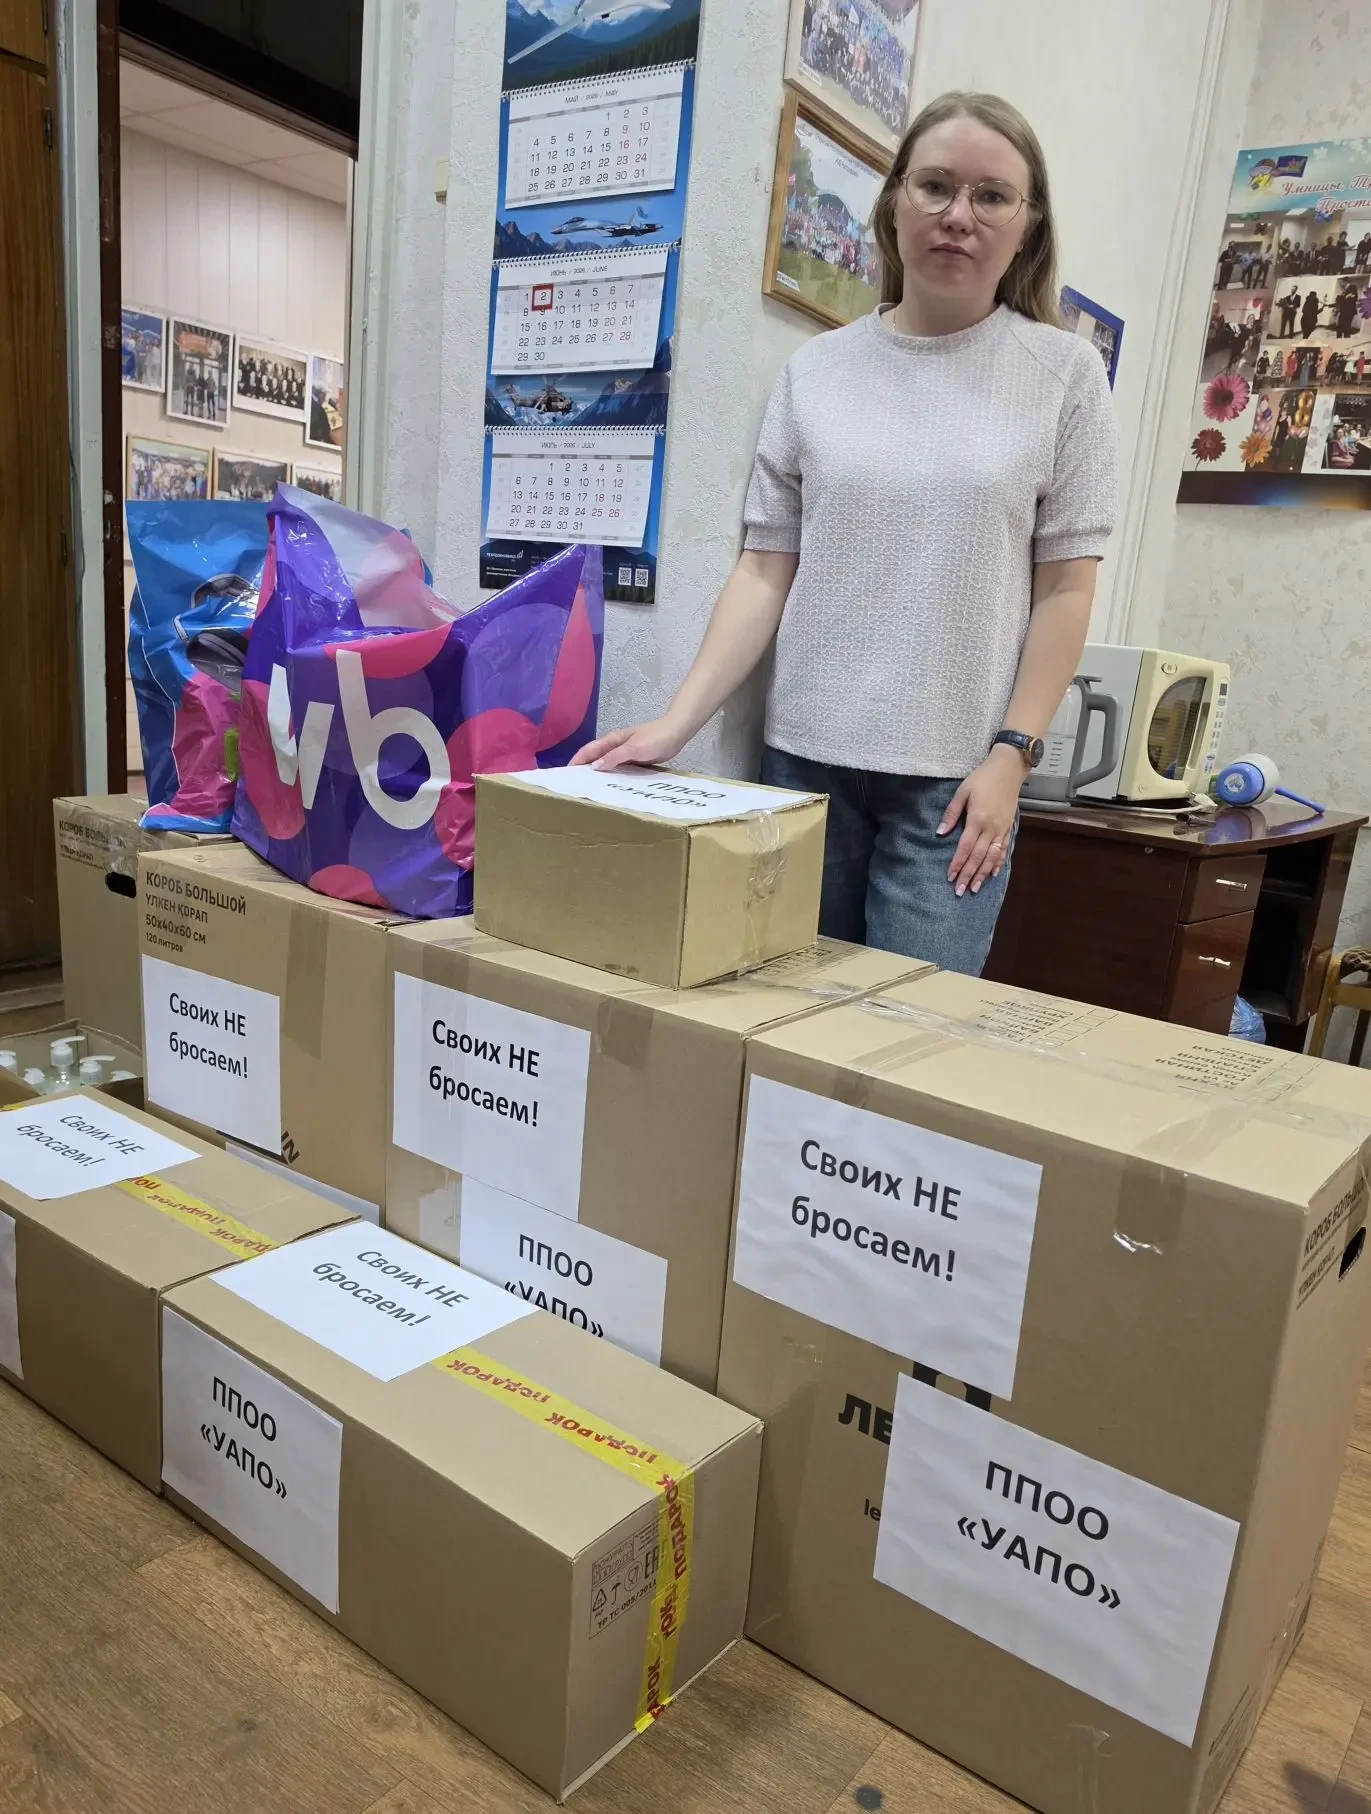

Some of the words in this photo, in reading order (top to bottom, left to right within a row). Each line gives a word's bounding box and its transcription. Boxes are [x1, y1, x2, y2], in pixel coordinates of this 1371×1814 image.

[624, 109, 630, 118] 2
[642, 106, 648, 116] 3
[550, 136, 556, 144] 5
[568, 133, 574, 142] 6
[586, 130, 592, 140] 7
[604, 128, 610, 136] 8
[622, 124, 628, 134] 9
[640, 121, 650, 131] 10
[531, 153, 540, 162] 11
[548, 150, 558, 159] 12
[565, 148, 576, 156] 13
[583, 145, 592, 154] 14
[601, 142, 611, 152] 15
[619, 140, 630, 149] 16
[638, 137, 648, 147] 17
[530, 168, 540, 176] 18
[547, 165, 556, 174] 19
[562, 162, 574, 172] 20
[580, 160, 590, 170] 21
[598, 158, 610, 168] 22
[616, 155, 628, 165] 23
[635, 153, 647, 163] 24
[528, 182, 538, 192] 25
[544, 180, 556, 190] 26
[562, 178, 572, 188] 27
[579, 176, 590, 185] 28
[597, 173, 608, 183] 29
[615, 170, 627, 180] 30
[634, 168, 644, 178] 31
[540, 292, 546, 300] 2
[558, 290, 564, 300] 3
[575, 289, 580, 298] 4
[592, 288, 598, 296] 5
[610, 286, 616, 295] 6
[628, 284, 634, 294] 7
[523, 308, 528, 316] 8
[554, 305, 566, 314] 10
[572, 304, 581, 313] 11
[589, 302, 600, 312] 12
[607, 301, 617, 310] 13
[625, 300, 634, 309] 14
[521, 322, 530, 332] 15
[537, 322, 547, 330] 16
[554, 320, 564, 330] 17
[571, 320, 581, 328] 18
[588, 318, 598, 328] 19
[604, 316, 616, 326] 20
[622, 316, 632, 325] 21
[518, 338, 529, 346] 22
[536, 336, 546, 346] 23
[552, 336, 562, 345] 24
[568, 334, 580, 344] 25
[585, 334, 596, 343] 26
[602, 332, 614, 342] 27
[620, 331, 631, 340] 28
[518, 352, 528, 362] 29
[534, 352, 545, 360] 30
[565, 462, 570, 472] 2
[582, 463, 588, 472] 3
[598, 464, 604, 472] 4
[616, 464, 622, 472] 5
[516, 476, 521, 485] 6
[532, 476, 537, 485] 7
[548, 477, 553, 486] 8
[564, 478, 570, 486] 9
[579, 478, 589, 487] 10
[596, 478, 605, 488] 11
[614, 478, 624, 488] 12
[513, 490, 522, 500] 13
[529, 492, 538, 500] 14
[545, 492, 554, 500] 15
[561, 492, 571, 501] 16
[578, 492, 588, 502] 17
[595, 494, 604, 502] 18
[612, 494, 622, 503] 19
[511, 504, 522, 513] 20
[526, 506, 536, 514] 21
[542, 506, 553, 514] 22
[558, 506, 569, 516] 23
[575, 508, 586, 516] 24
[592, 508, 603, 517] 25
[608, 508, 620, 518] 26
[509, 518, 520, 527] 27
[525, 520, 536, 528] 28
[540, 520, 551, 528] 29
[557, 521, 568, 530] 30
[573, 522, 582, 530] 31
[606, 783, 706, 808] «УАПО»
[648, 782, 726, 799] ППОО
[146, 872, 183, 894] КОРОБ
[185, 882, 246, 916] БОЛЬШОЙ
[146, 932, 157, 944] 120
[158, 937, 183, 952] литров
[193, 931, 206, 944] см
[169, 992, 219, 1028] Своих
[224, 1010, 246, 1037] НЕ
[169, 1032, 248, 1079] бросаем!
[432, 1019, 502, 1064] Своих
[508, 1043, 540, 1078] НЕ
[1192, 1045, 1270, 1065] ДЕТСКАЯ
[1155, 1058, 1247, 1082] ГОСТИНАЯ
[1177, 1052, 1258, 1073] СПАЛЬНЯ
[428, 1066, 538, 1127] бросаем!
[16, 1124, 104, 1167] бросаем!
[59, 1114, 111, 1141] Своих
[108, 1135, 145, 1156] НЕ
[801, 1139, 901, 1200] Своих
[914, 1176, 961, 1221] НЕ
[792, 1195, 956, 1282] бросаем!
[519, 1234, 593, 1286] ППОО
[356, 1250, 430, 1290] Своих
[425, 1279, 470, 1308] НЕ
[312, 1262, 432, 1328] бросаем!
[504, 1280, 604, 1338] «УАПО»
[212, 1376, 278, 1443] ППОО
[446, 1359, 551, 1404] ПОДАРОК
[544, 1412, 657, 1464] ПОДАРОК
[200, 1422, 288, 1500] «УАПО»
[986, 1460, 1109, 1542] ППОО
[956, 1514, 1122, 1610] «УАПО»
[621, 1580, 657, 1610] 005/2011
